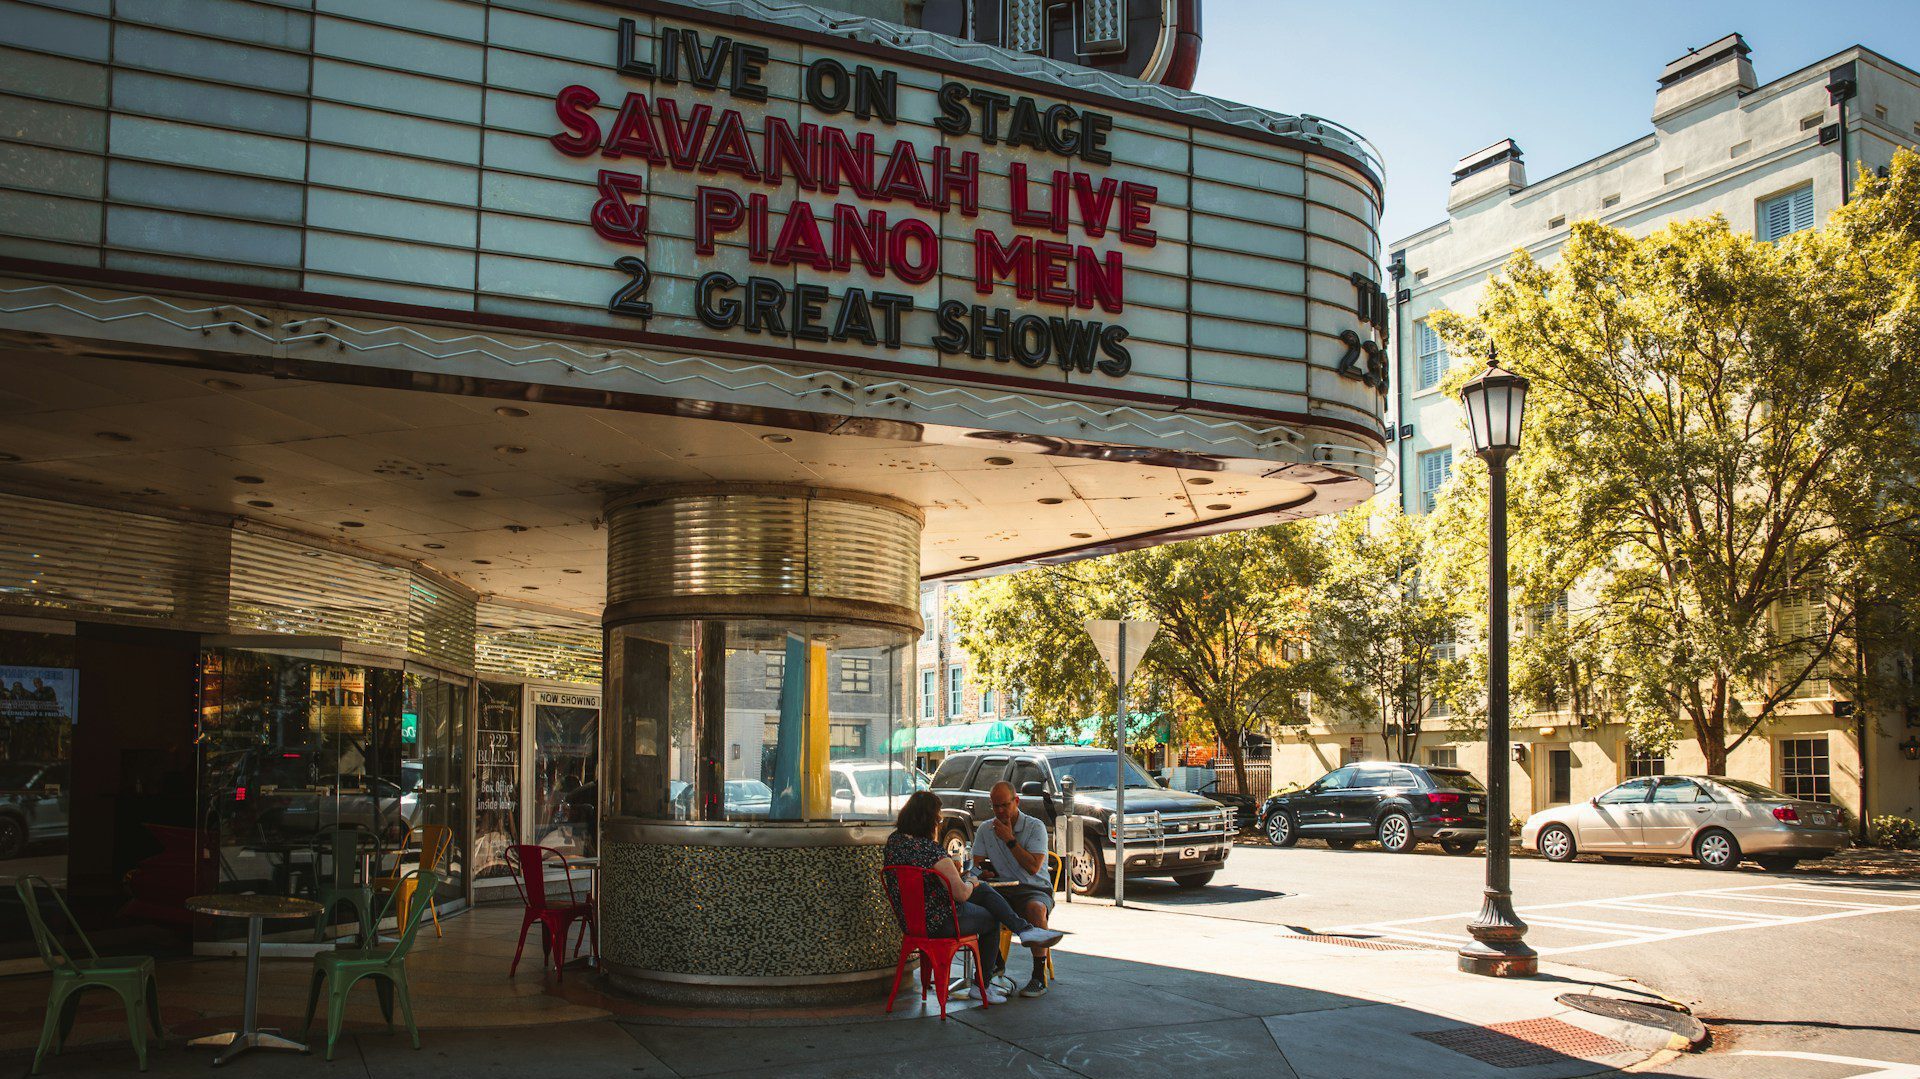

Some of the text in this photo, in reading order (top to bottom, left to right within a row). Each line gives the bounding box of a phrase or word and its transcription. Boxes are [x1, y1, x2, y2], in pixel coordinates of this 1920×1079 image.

[617, 17, 1113, 166] LIVE ON STAGE
[550, 84, 1158, 248] SAVANNAH LIVE
[590, 169, 1124, 314] & PIANO MEN
[607, 255, 1133, 378] 2 GREAT SHOWS
[540, 693, 596, 706] NOW SHOWING
[489, 734, 508, 747] 222
[478, 749, 503, 762] BULL
[481, 781, 514, 794] Box Office
[478, 798, 498, 810] inside
[1184, 847, 1195, 857] G
